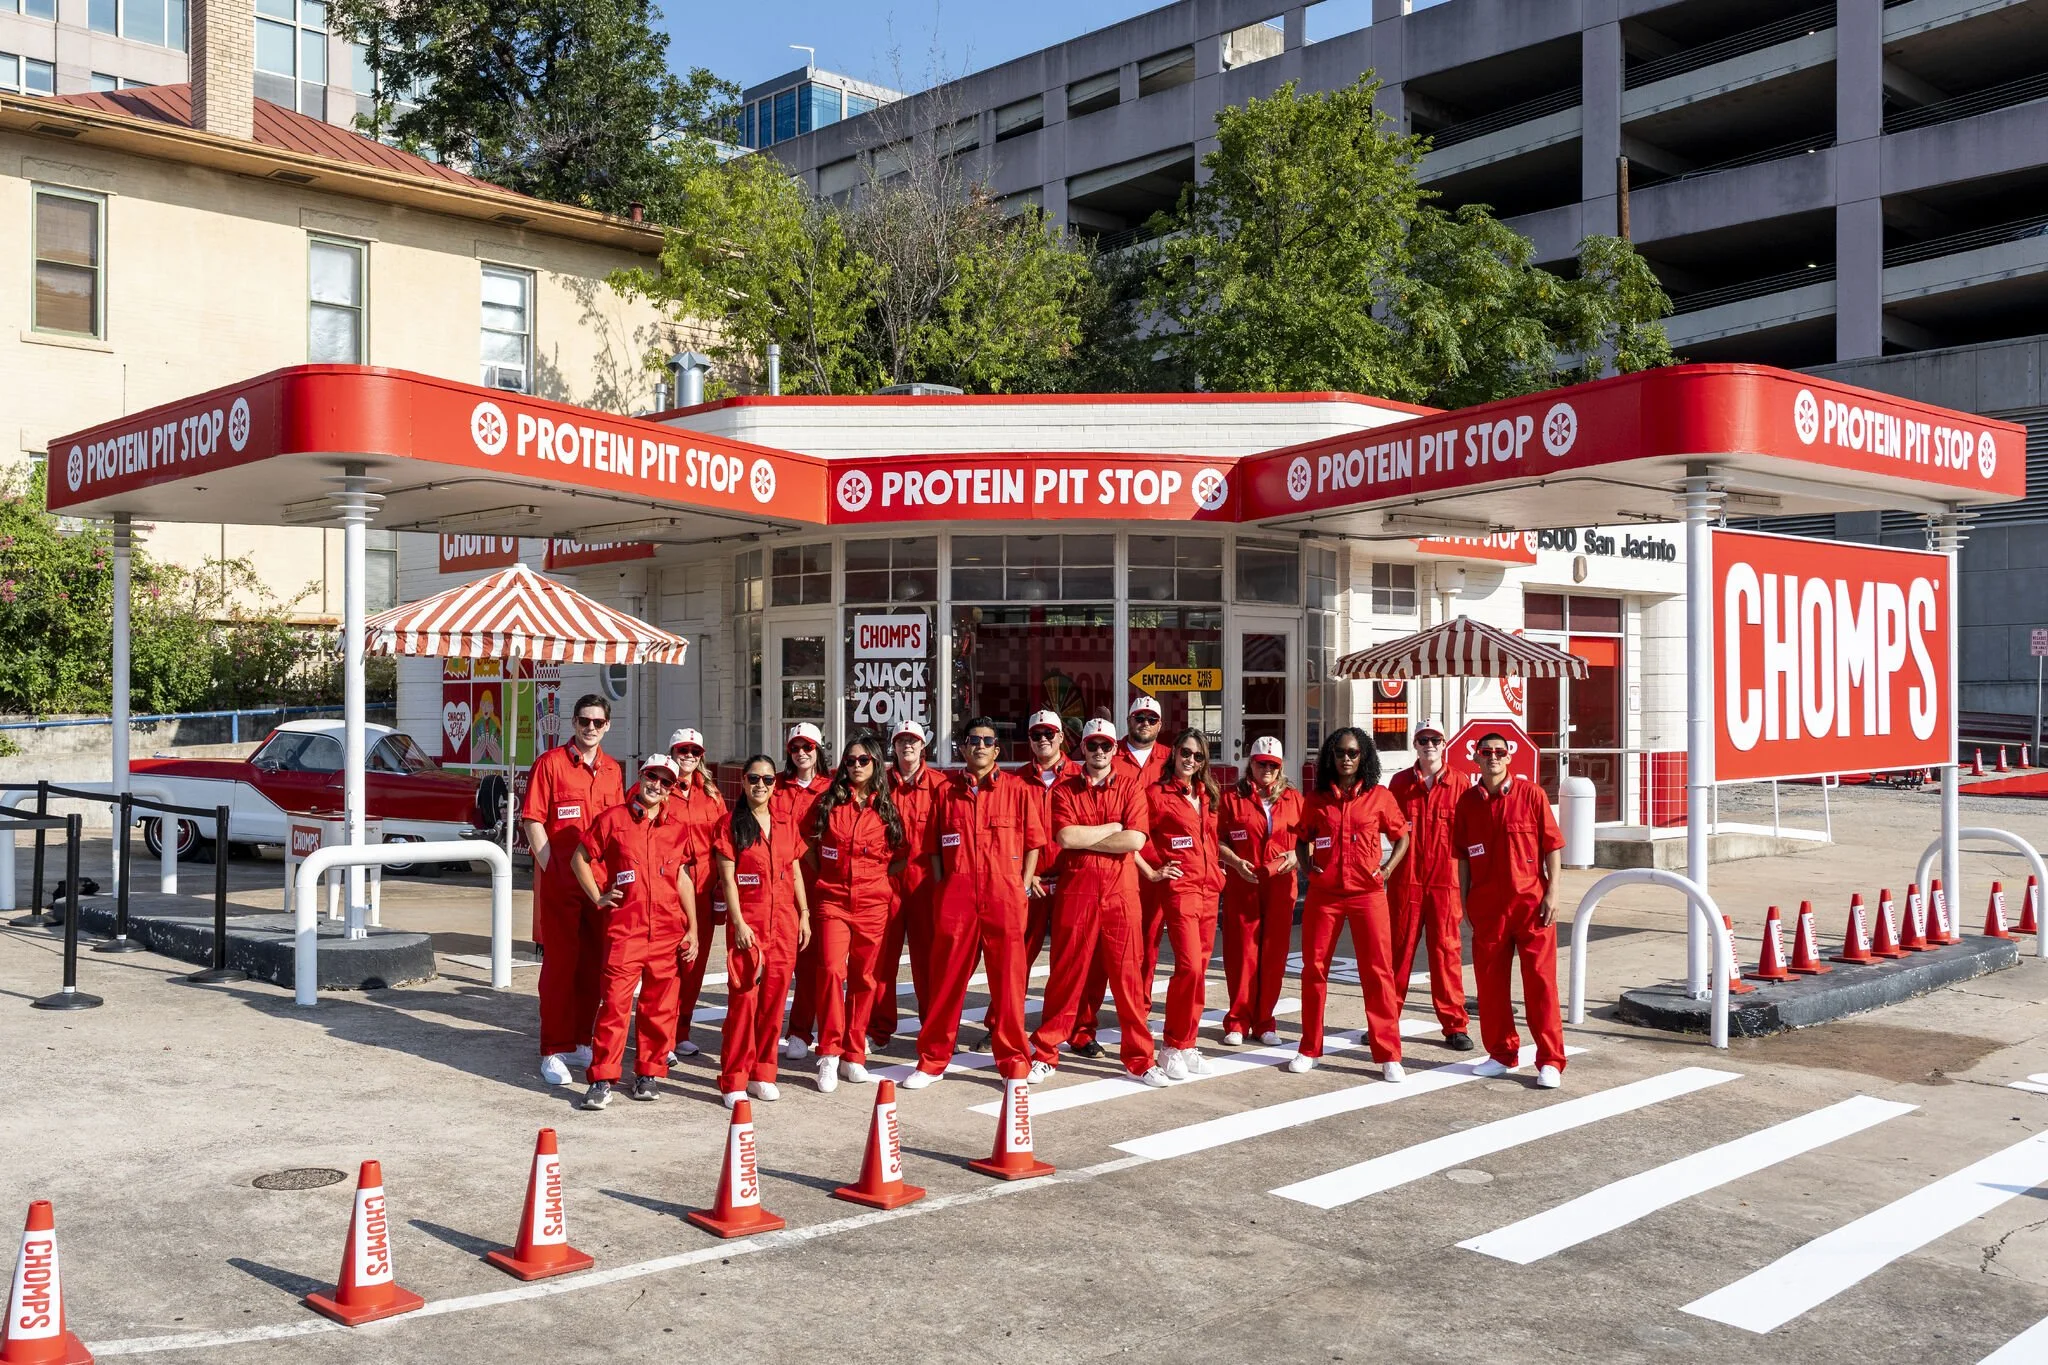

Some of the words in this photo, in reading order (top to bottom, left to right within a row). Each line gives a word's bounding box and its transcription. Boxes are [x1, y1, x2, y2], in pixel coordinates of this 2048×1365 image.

[86, 430, 149, 484] PROTEIN
[151, 422, 178, 468] PIT
[180, 409, 224, 461] STOP
[1823, 399, 1901, 459] PROTEIN
[1904, 419, 1931, 465] PIT
[1934, 425, 1974, 471] STOP
[516, 413, 634, 477] PROTEIN
[640, 439, 680, 484] PIT
[685, 448, 744, 494] STOP
[1317, 438, 1412, 493] PROTEIN
[1418, 429, 1458, 475] PIT
[1464, 415, 1534, 467] STOP
[881, 468, 1023, 507] PROTEIN
[1034, 468, 1089, 504] PIT
[1097, 468, 1182, 505] STOP
[1584, 528, 1615, 556] San
[1621, 533, 1676, 562] Jacinto
[860, 623, 921, 649] CHOMPS
[1724, 561, 1938, 752] CHOMPS
[853, 661, 927, 688] SNACK
[1142, 674, 1192, 686] ENTRANCE
[1197, 670, 1212, 679] THIS
[1197, 679, 1213, 688] WAY
[447, 711, 466, 722] SNACKS
[853, 691, 927, 723] ZONE
[449, 721, 465, 741] Life
[1465, 739, 1518, 760] SP
[558, 808, 580, 817] CHOMPS
[293, 830, 319, 851] CHOMPS
[1172, 838, 1192, 848] CHOMPS
[738, 875, 758, 883] CHOMPS
[1013, 1085, 1030, 1146] CHOMPS
[885, 1109, 902, 1174] CHOMPS
[738, 1130, 757, 1199] CHOMPS
[543, 1162, 563, 1237] CHOMPS
[365, 1194, 389, 1277] CHOMPS
[20, 1239, 53, 1329] CHOMPS
